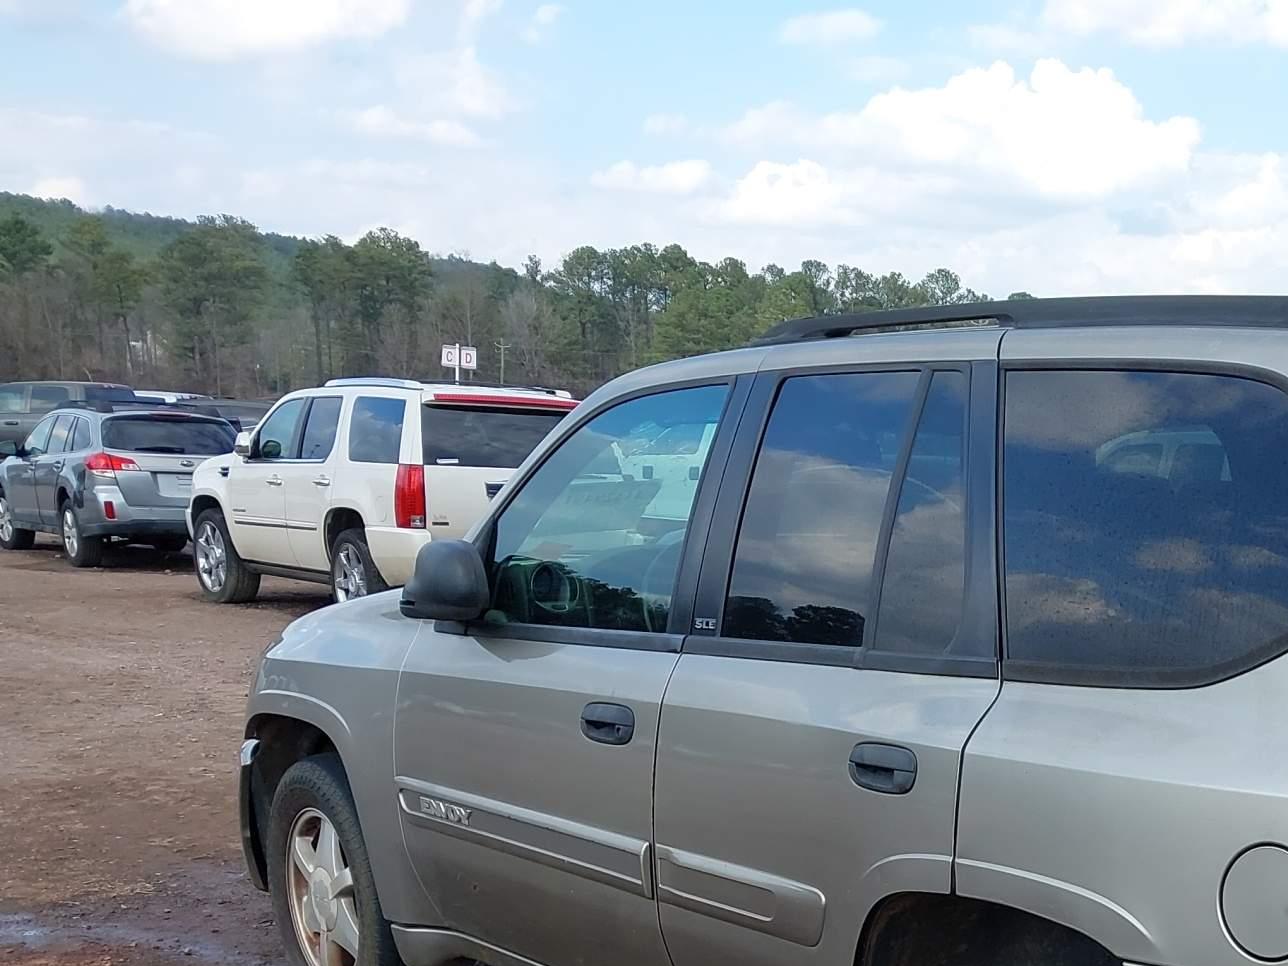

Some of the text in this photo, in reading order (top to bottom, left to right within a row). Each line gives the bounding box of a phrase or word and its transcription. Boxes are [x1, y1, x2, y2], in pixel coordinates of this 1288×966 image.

[446, 351, 453, 362] C
[465, 352, 472, 364] D
[694, 617, 717, 629] SLE
[419, 796, 472, 826] ENVOY
